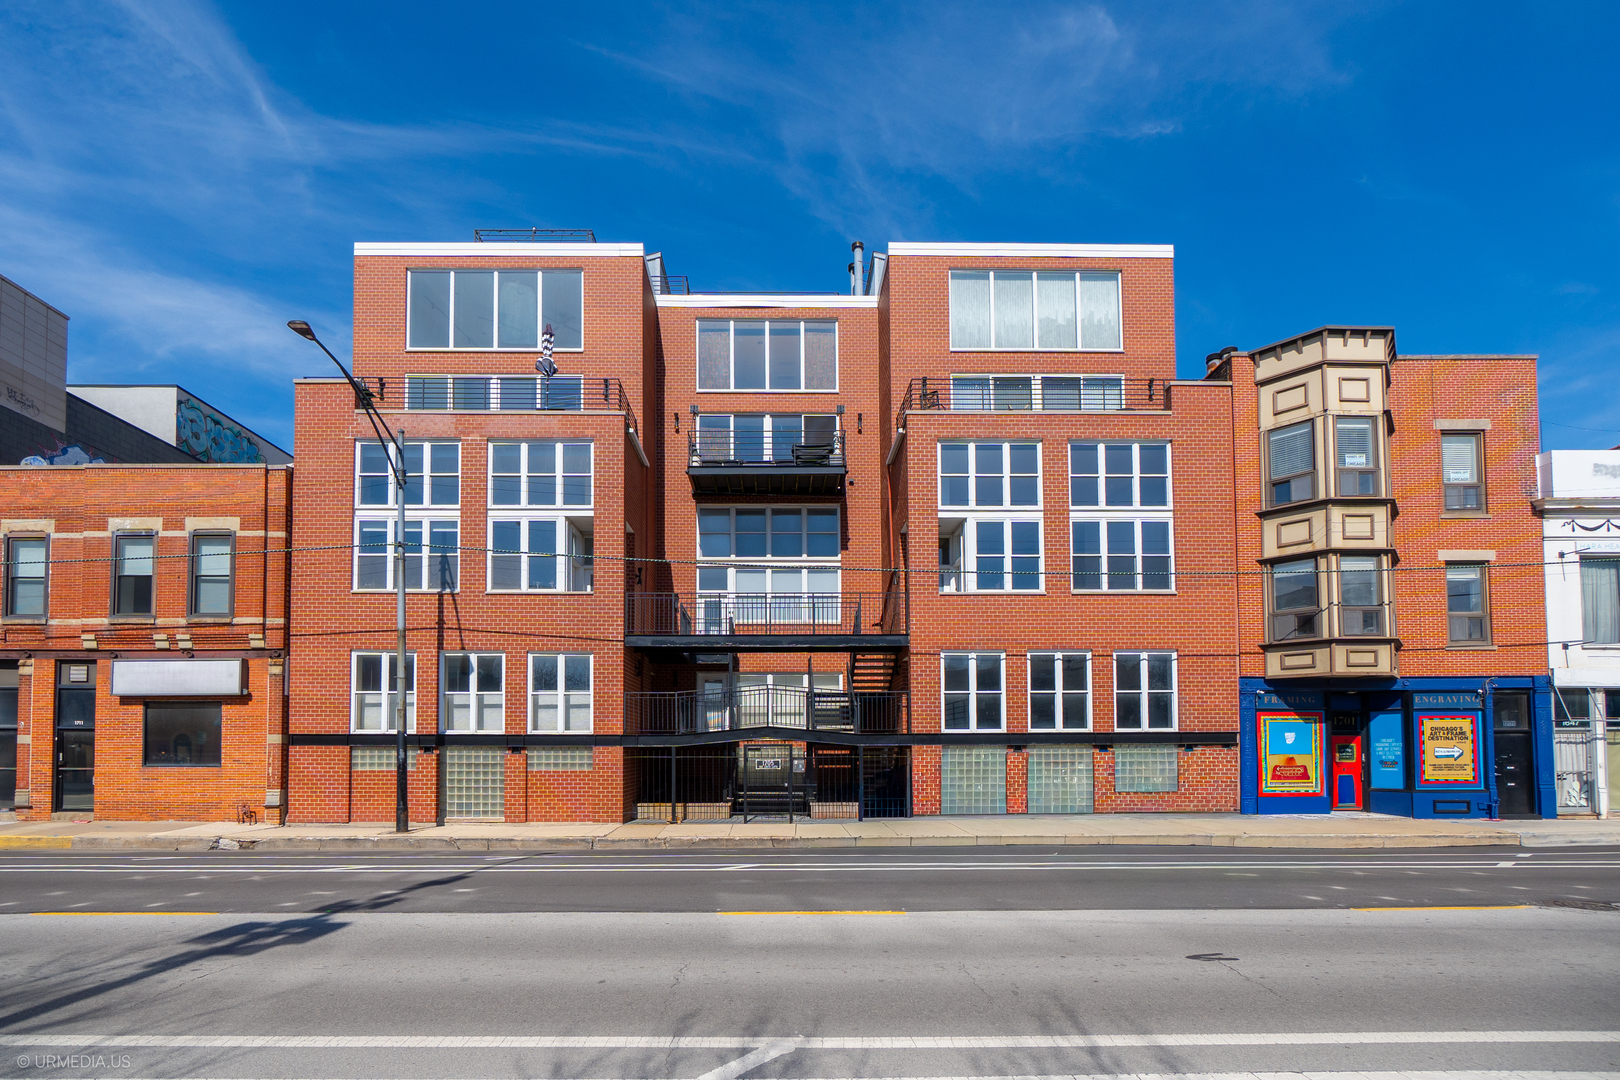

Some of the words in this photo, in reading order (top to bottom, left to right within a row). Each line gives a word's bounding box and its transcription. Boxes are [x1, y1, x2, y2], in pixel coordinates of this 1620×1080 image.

[1264, 696, 1316, 704] FRAMING
[1414, 695, 1479, 703] ENGRAVING
[1334, 716, 1355, 725] 1701
